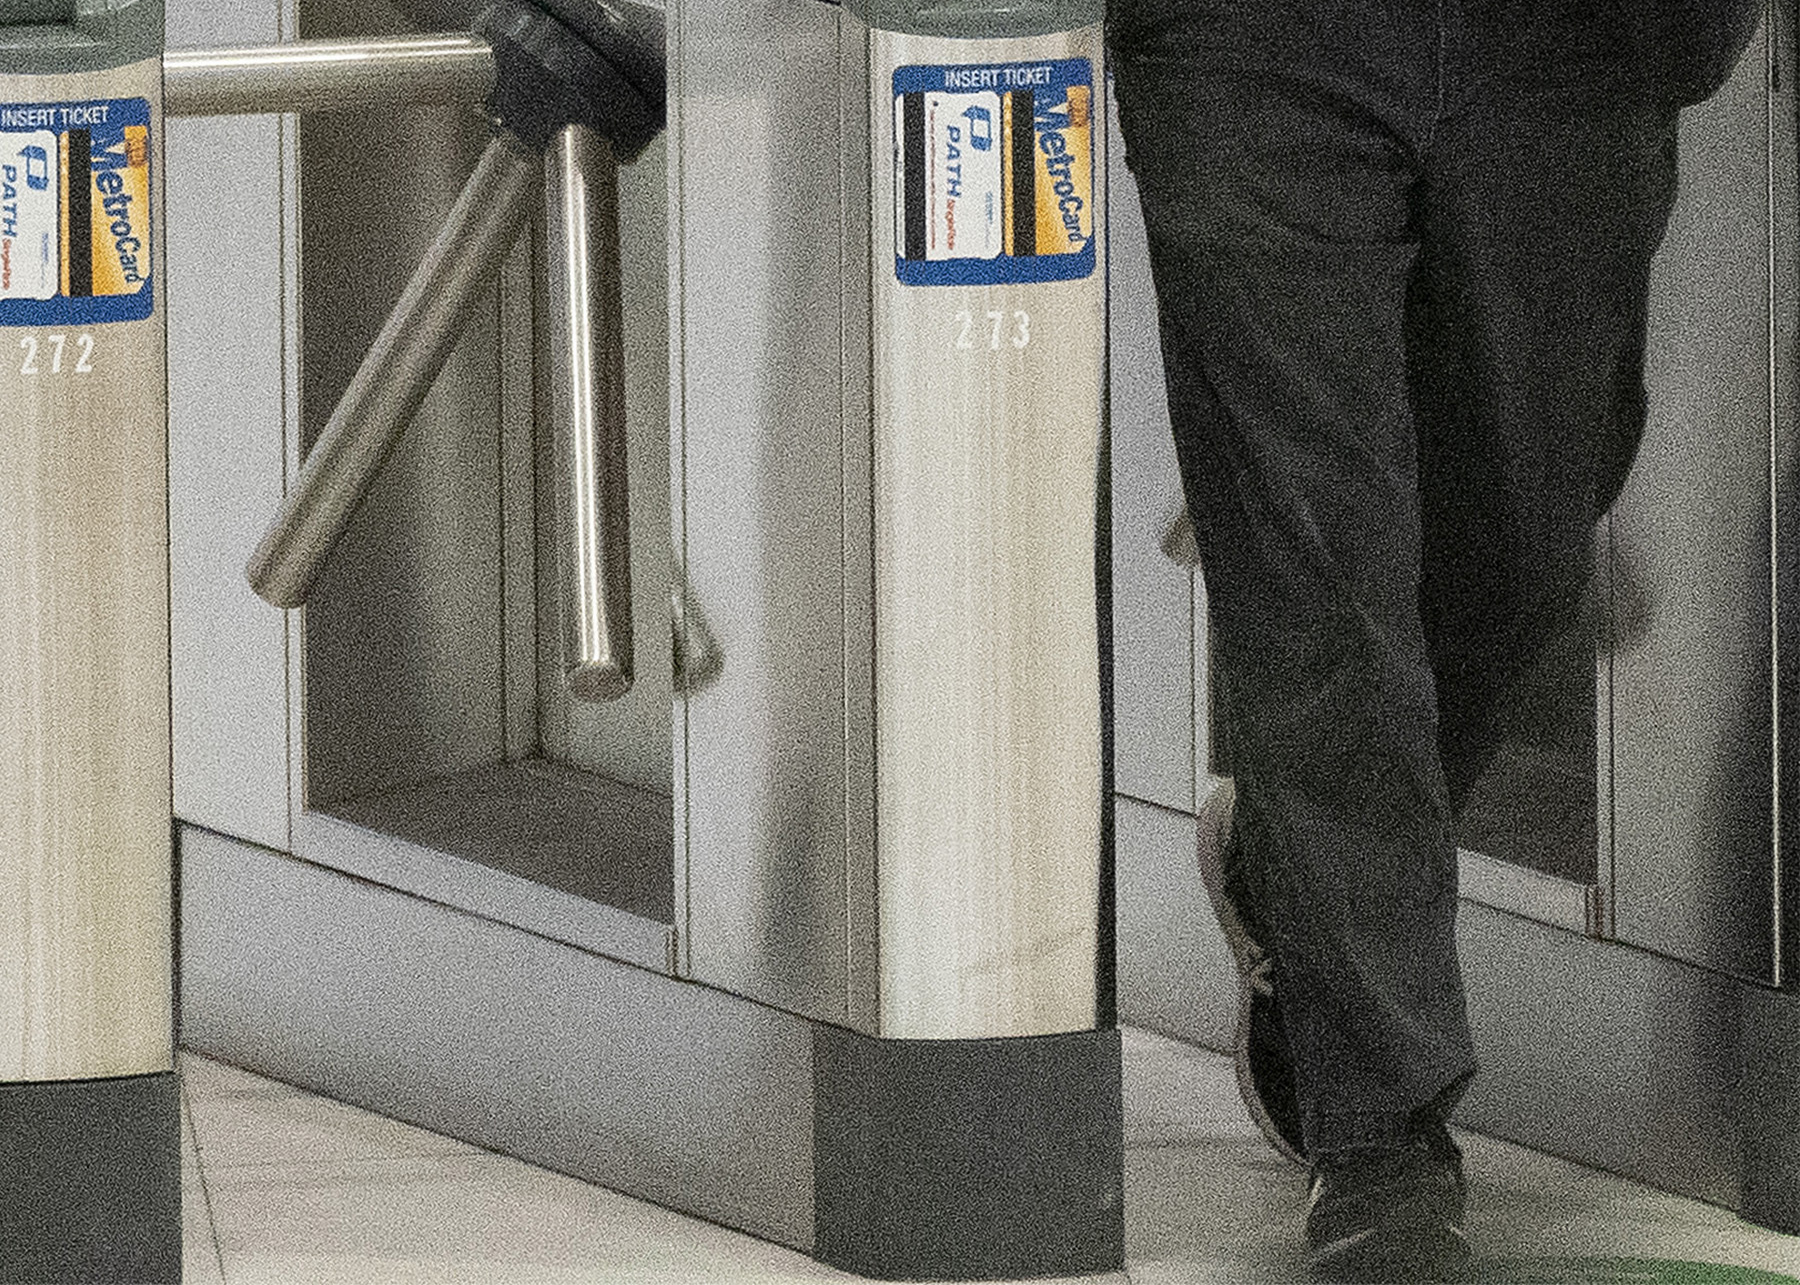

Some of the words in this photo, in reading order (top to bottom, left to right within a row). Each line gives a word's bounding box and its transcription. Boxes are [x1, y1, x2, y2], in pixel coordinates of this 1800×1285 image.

[945, 68, 999, 87] INSERT
[1004, 67, 1053, 85] TICKET
[1, 108, 56, 127] INSERT
[61, 106, 109, 125] TICKET
[947, 125, 962, 198] PATH
[1033, 97, 1087, 242] MetroCard
[2, 164, 18, 238] PATH
[90, 136, 146, 284] MetroCard
[20, 334, 95, 375] 272
[955, 310, 1031, 351] 273
